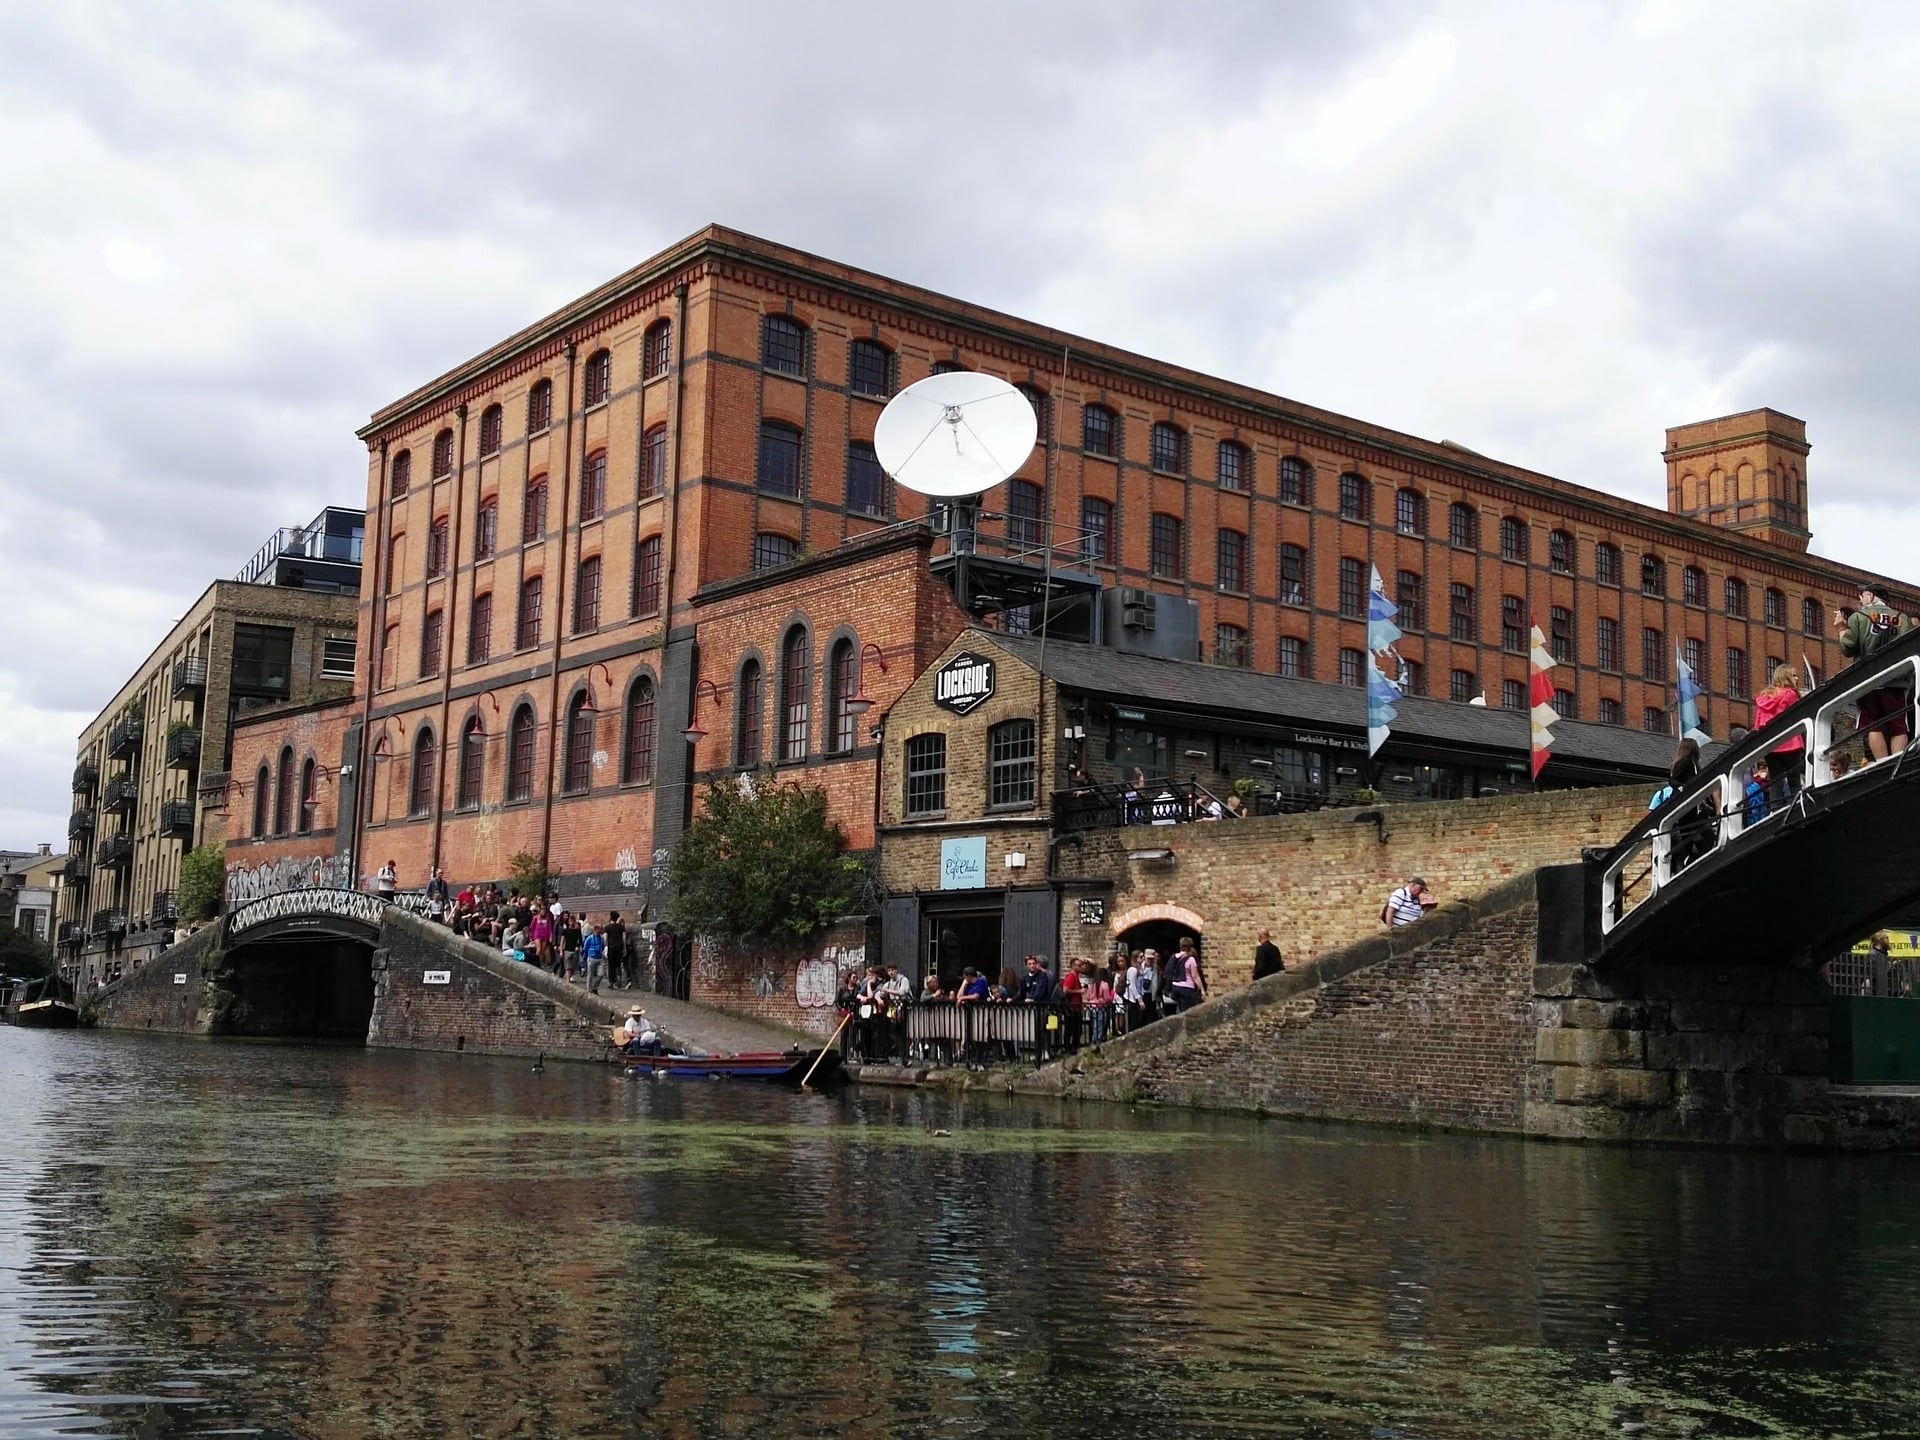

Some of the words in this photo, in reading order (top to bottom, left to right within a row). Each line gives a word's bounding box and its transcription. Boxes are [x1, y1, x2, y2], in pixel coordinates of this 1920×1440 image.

[937, 662, 991, 701] LOCKSIDE
[1295, 733, 1327, 746] Lockside
[1328, 738, 1342, 747] Bar
[1343, 740, 1349, 748] &
[1350, 741, 1369, 751] Kitch
